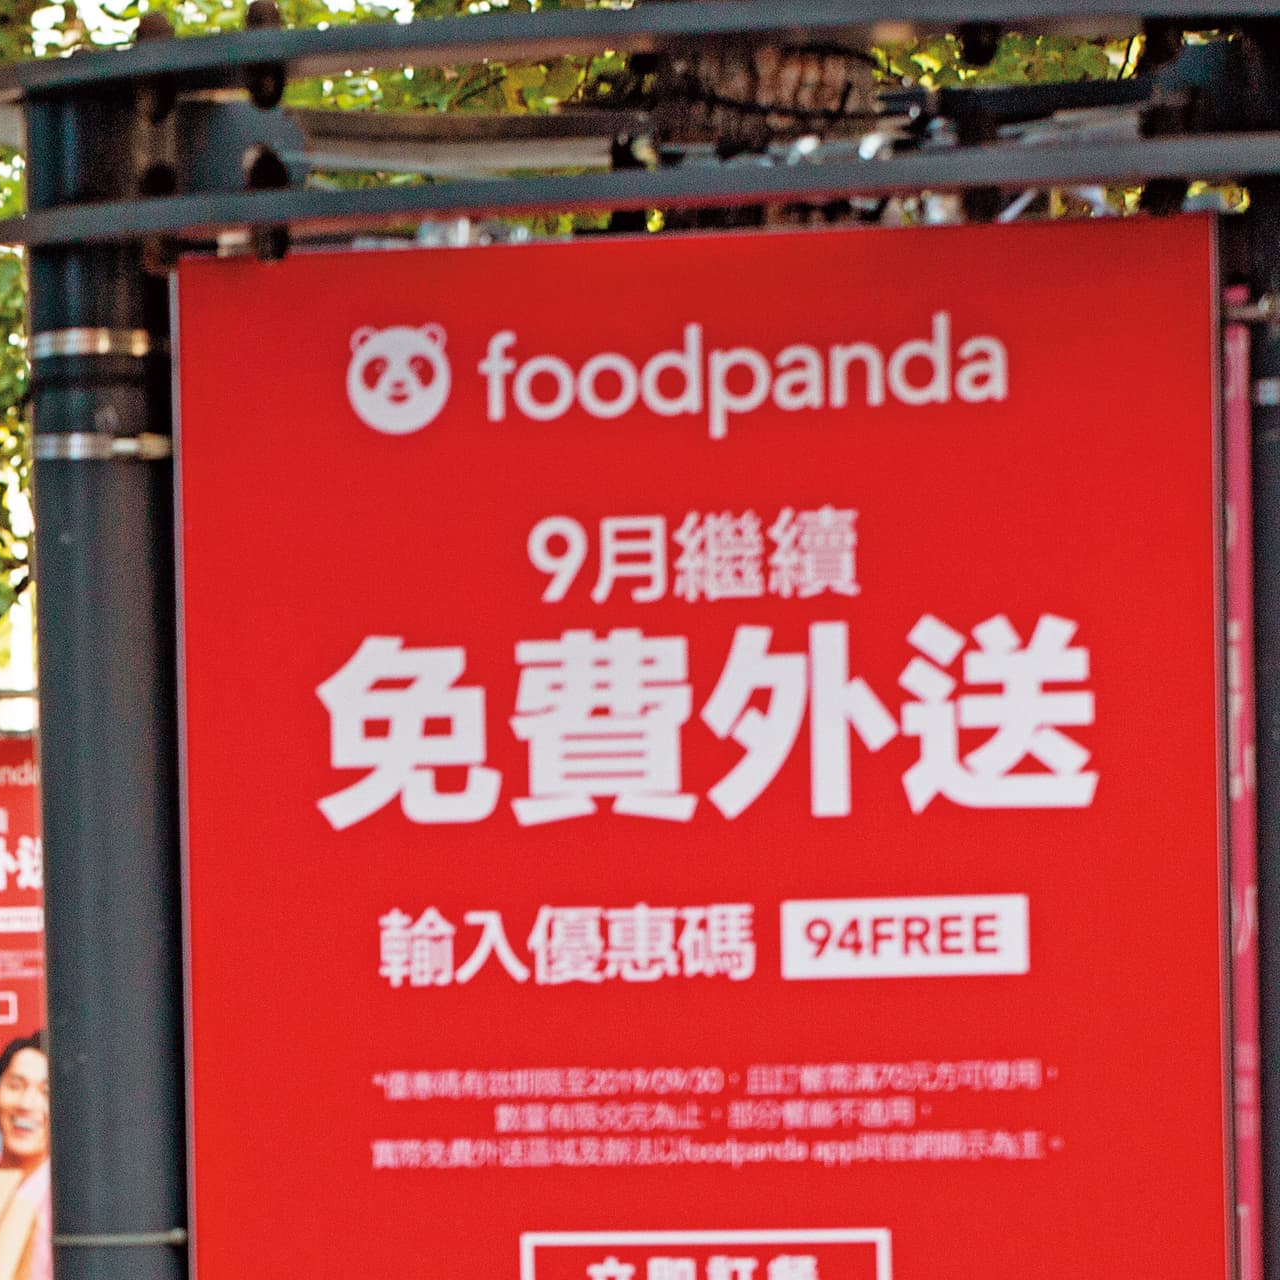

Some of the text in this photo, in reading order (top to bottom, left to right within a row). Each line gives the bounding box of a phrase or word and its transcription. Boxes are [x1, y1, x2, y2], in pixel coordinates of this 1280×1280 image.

[480, 313, 1008, 439] foodpanda
[527, 506, 861, 604] 9月繼續
[317, 614, 1100, 831] 免費外送
[380, 903, 1002, 987] 輸入優惠碼 94FREE
